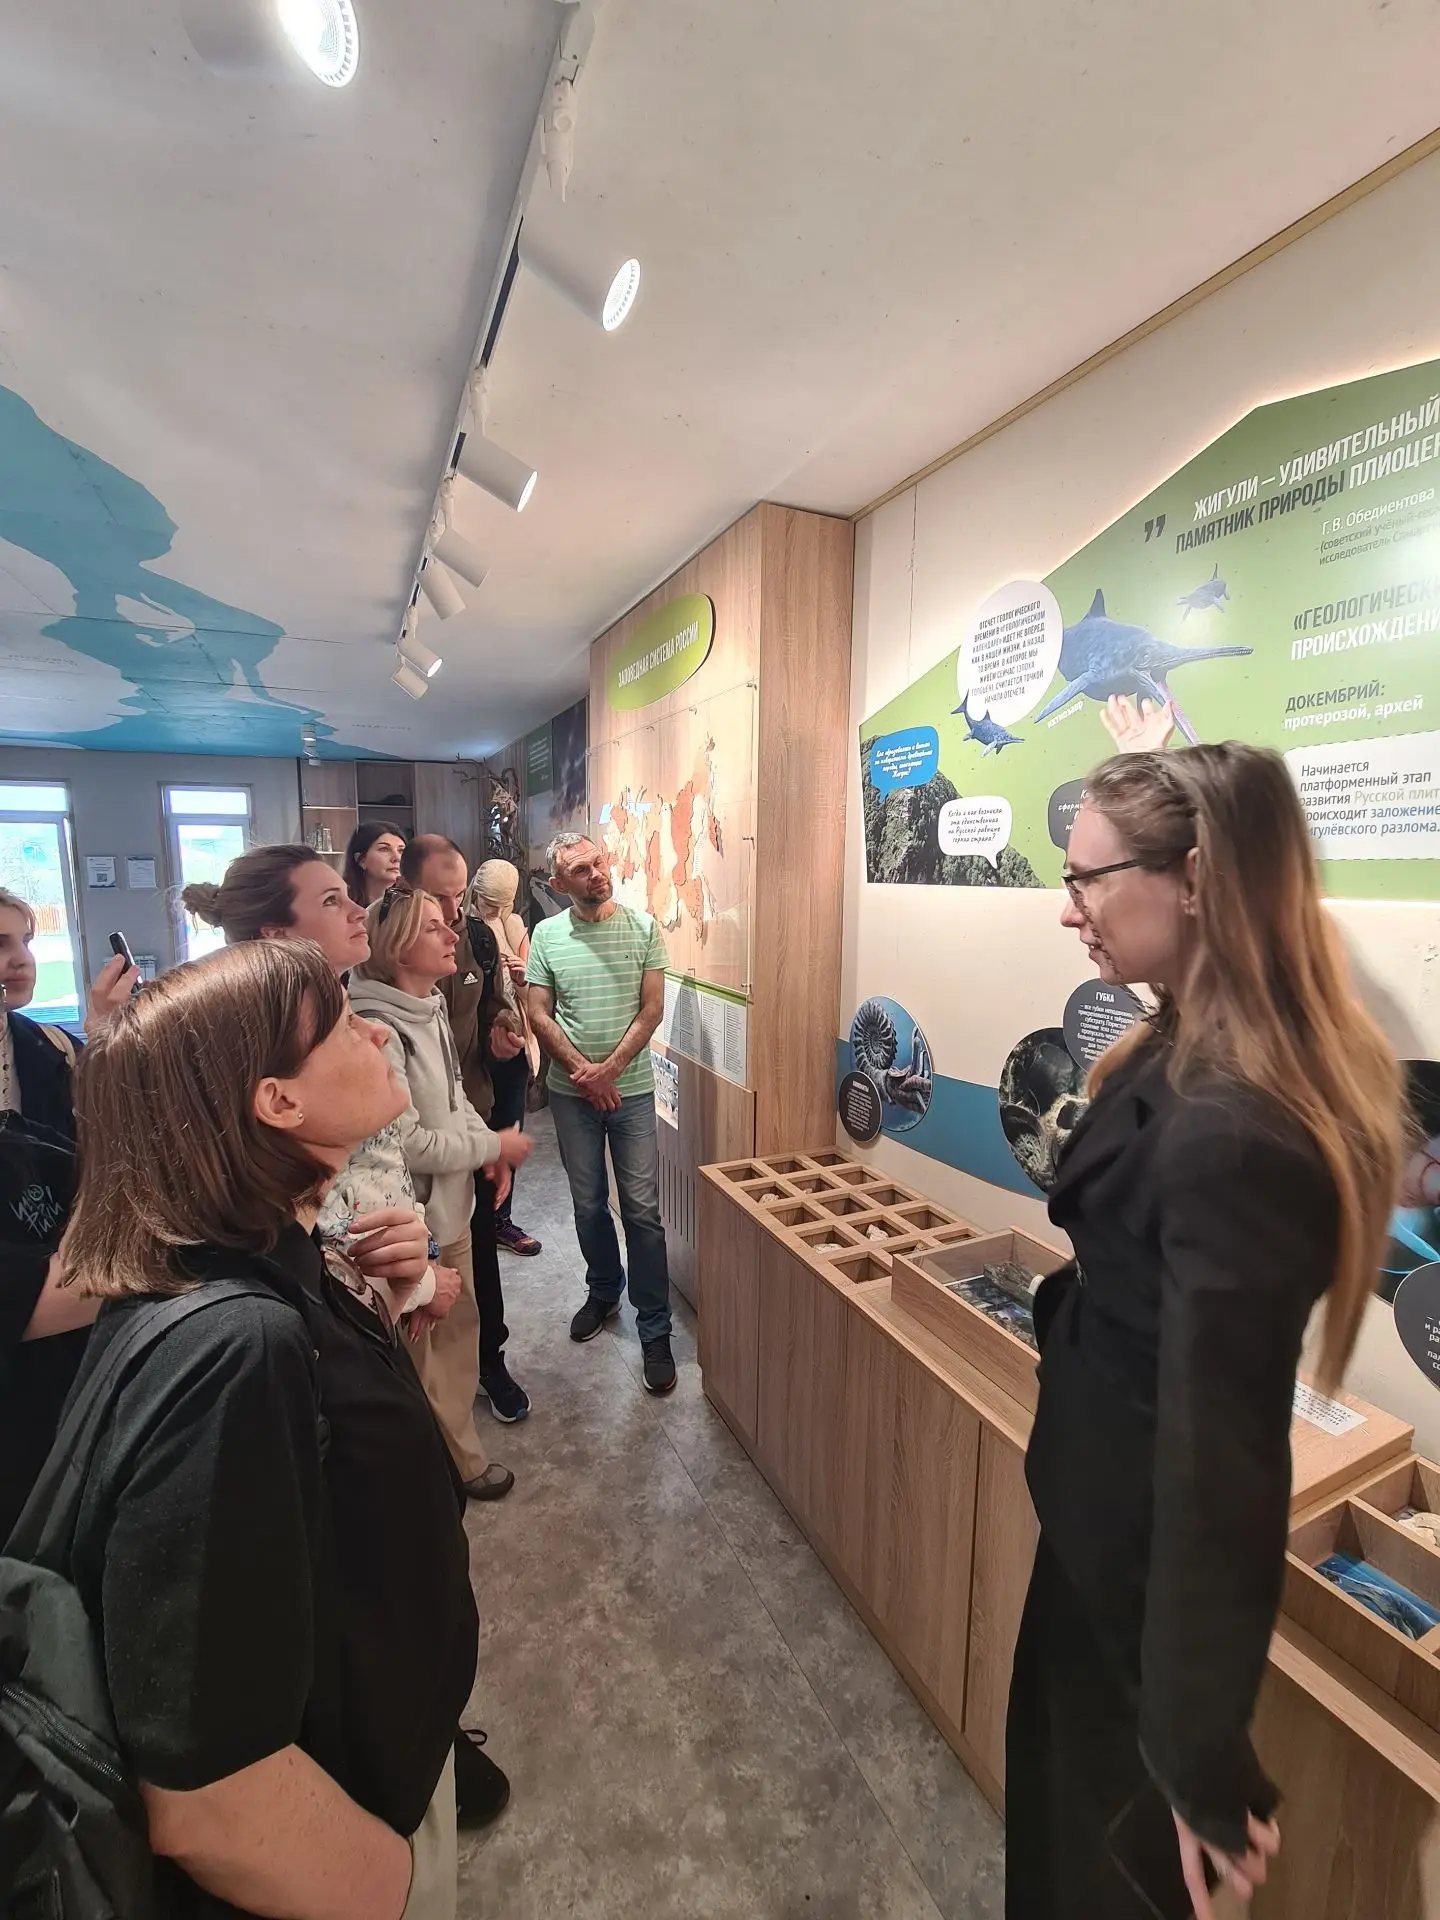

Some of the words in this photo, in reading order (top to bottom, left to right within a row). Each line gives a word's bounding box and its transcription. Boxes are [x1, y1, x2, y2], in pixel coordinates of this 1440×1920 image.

[1193, 475, 1258, 521] ЖИГУЛИ
[1279, 393, 1440, 487] УДИВИТЕЛЬНЫЙ
[1175, 507, 1254, 554] ПАМЯТНИК
[1258, 469, 1345, 523] ПРИРОДЫ
[1322, 520, 1330, 535] Г.
[1333, 517, 1343, 532] В.
[1347, 487, 1435, 527] Обедиентова
[649, 638, 675, 669] СИСТЕМА
[675, 620, 698, 654] РОССИИ
[1285, 679, 1386, 713] ДОКЕМБРИЙ:
[1284, 703, 1371, 731] протерозой,
[1375, 694, 1424, 718] архей
[1300, 772, 1398, 792] платформенный
[1402, 771, 1431, 784] этап
[1301, 761, 1369, 776] Начинается
[1355, 788, 1404, 806] Русской
[1306, 809, 1367, 821] роисходит
[1370, 805, 1440, 818] заложение
[1310, 823, 1377, 839] игулёвского
[1381, 821, 1440, 837] разлома.
[1095, 991, 1115, 1003] ГУБКА
